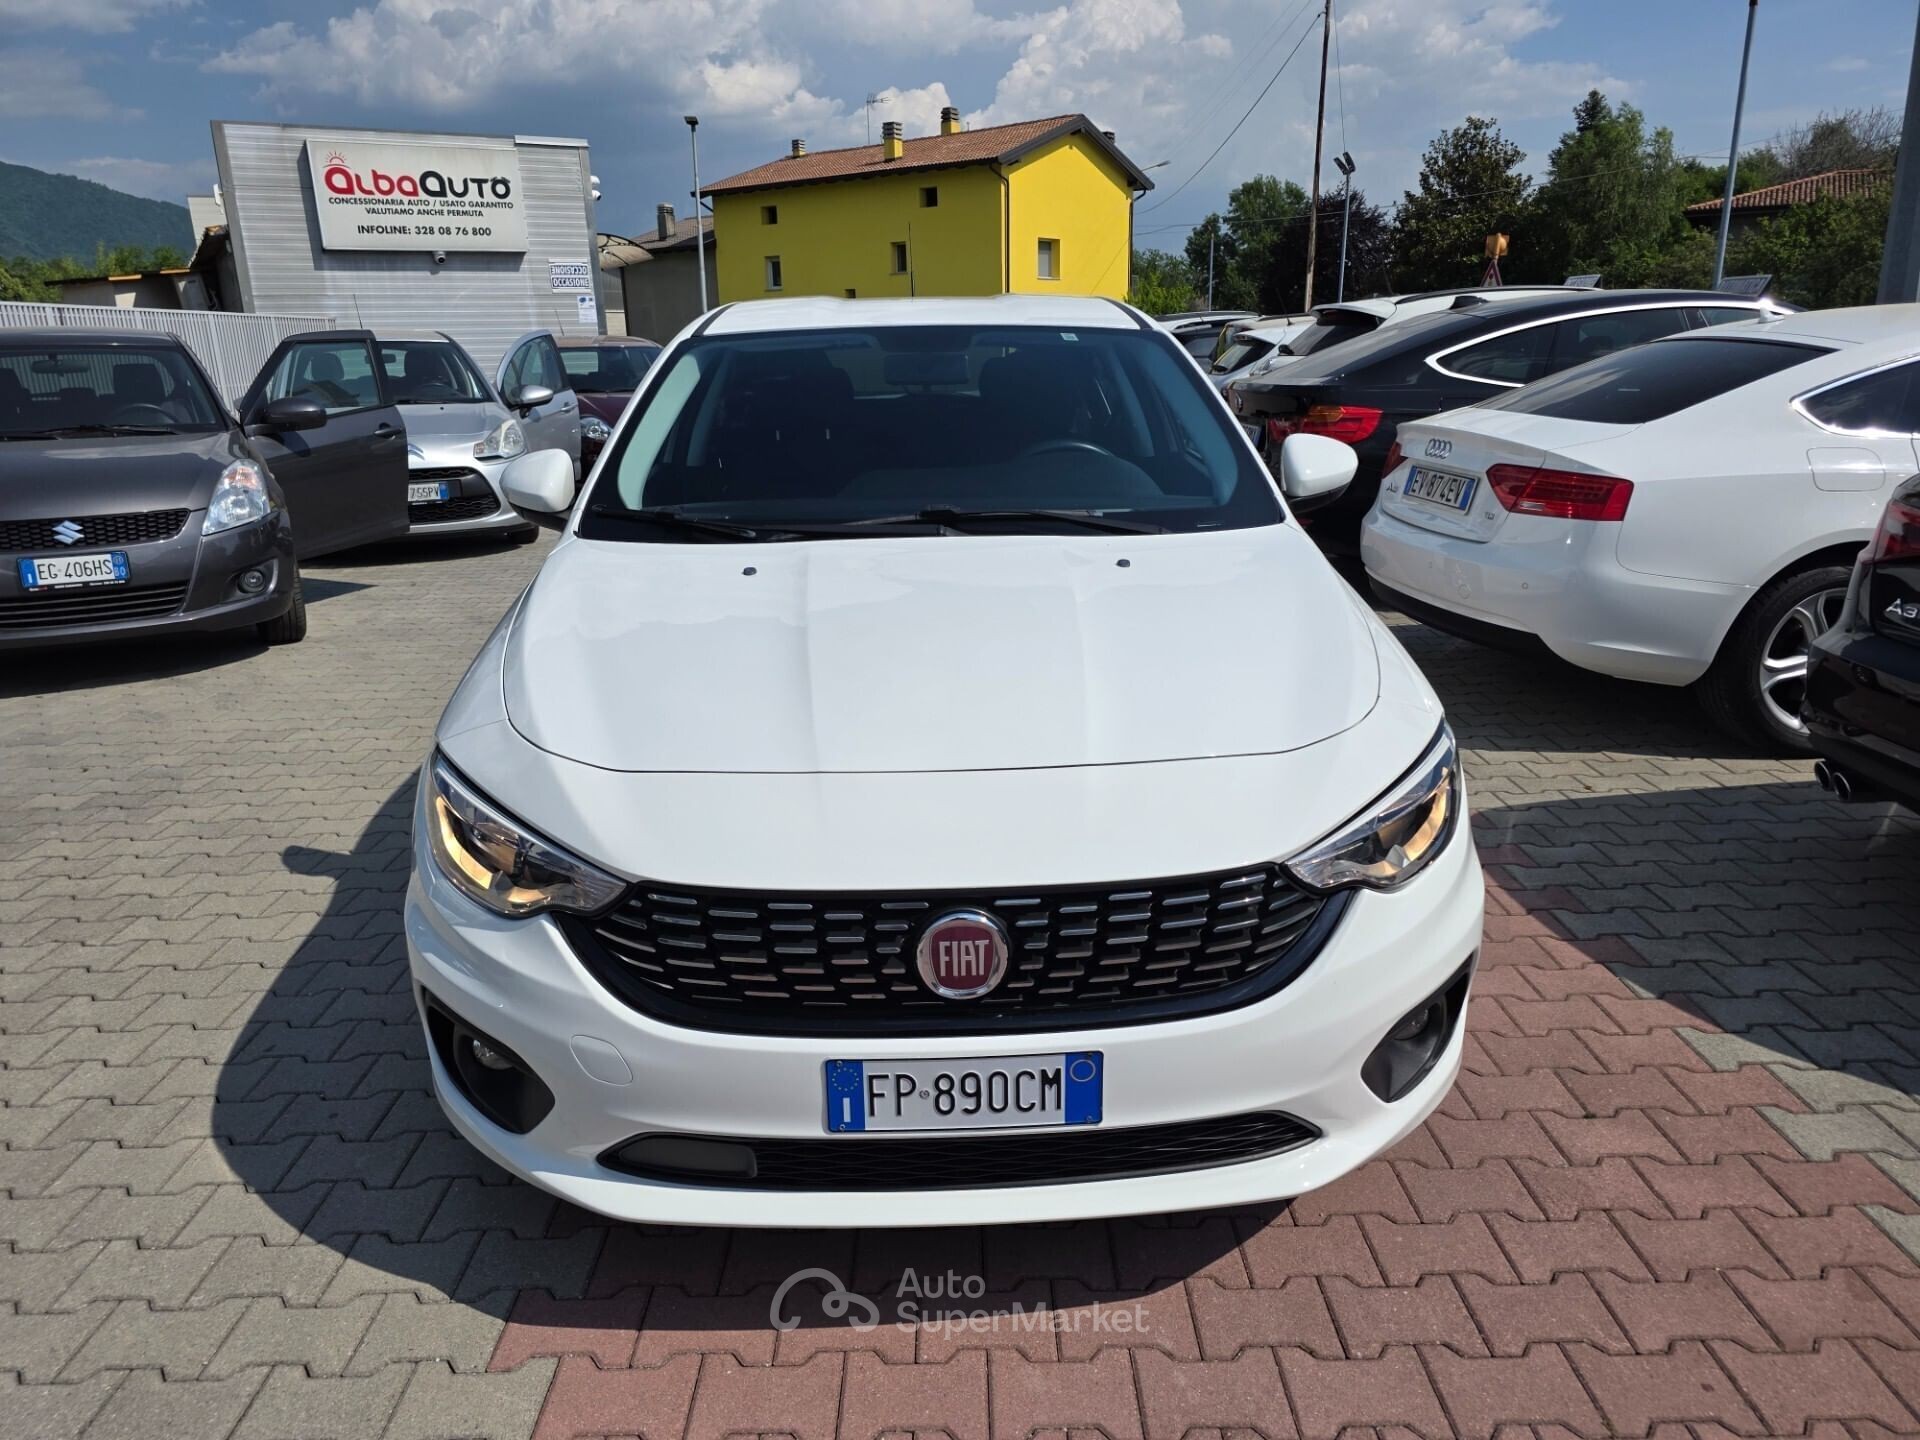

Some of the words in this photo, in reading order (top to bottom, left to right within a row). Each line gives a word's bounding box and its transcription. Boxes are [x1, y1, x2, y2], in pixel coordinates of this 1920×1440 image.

[328, 197, 405, 206] CONCESSIONARIA
[407, 199, 430, 207] AUTO
[439, 200, 467, 208] USATO
[468, 201, 514, 209] GARANTITO
[365, 207, 414, 216] VALUTIAMO
[357, 225, 412, 235] INFOLINE:
[414, 226, 435, 235] 328
[438, 226, 452, 236] 08
[455, 227, 469, 236] 76
[472, 227, 492, 236] 800
[553, 278, 589, 287] OCCASIONE
[37, 563, 58, 580] EG
[64, 559, 113, 579] 406HS
[1885, 598, 1918, 618] A3
[939, 940, 990, 977] FIAT
[867, 1073, 918, 1117] FP
[933, 1067, 1063, 1116] 890CM
